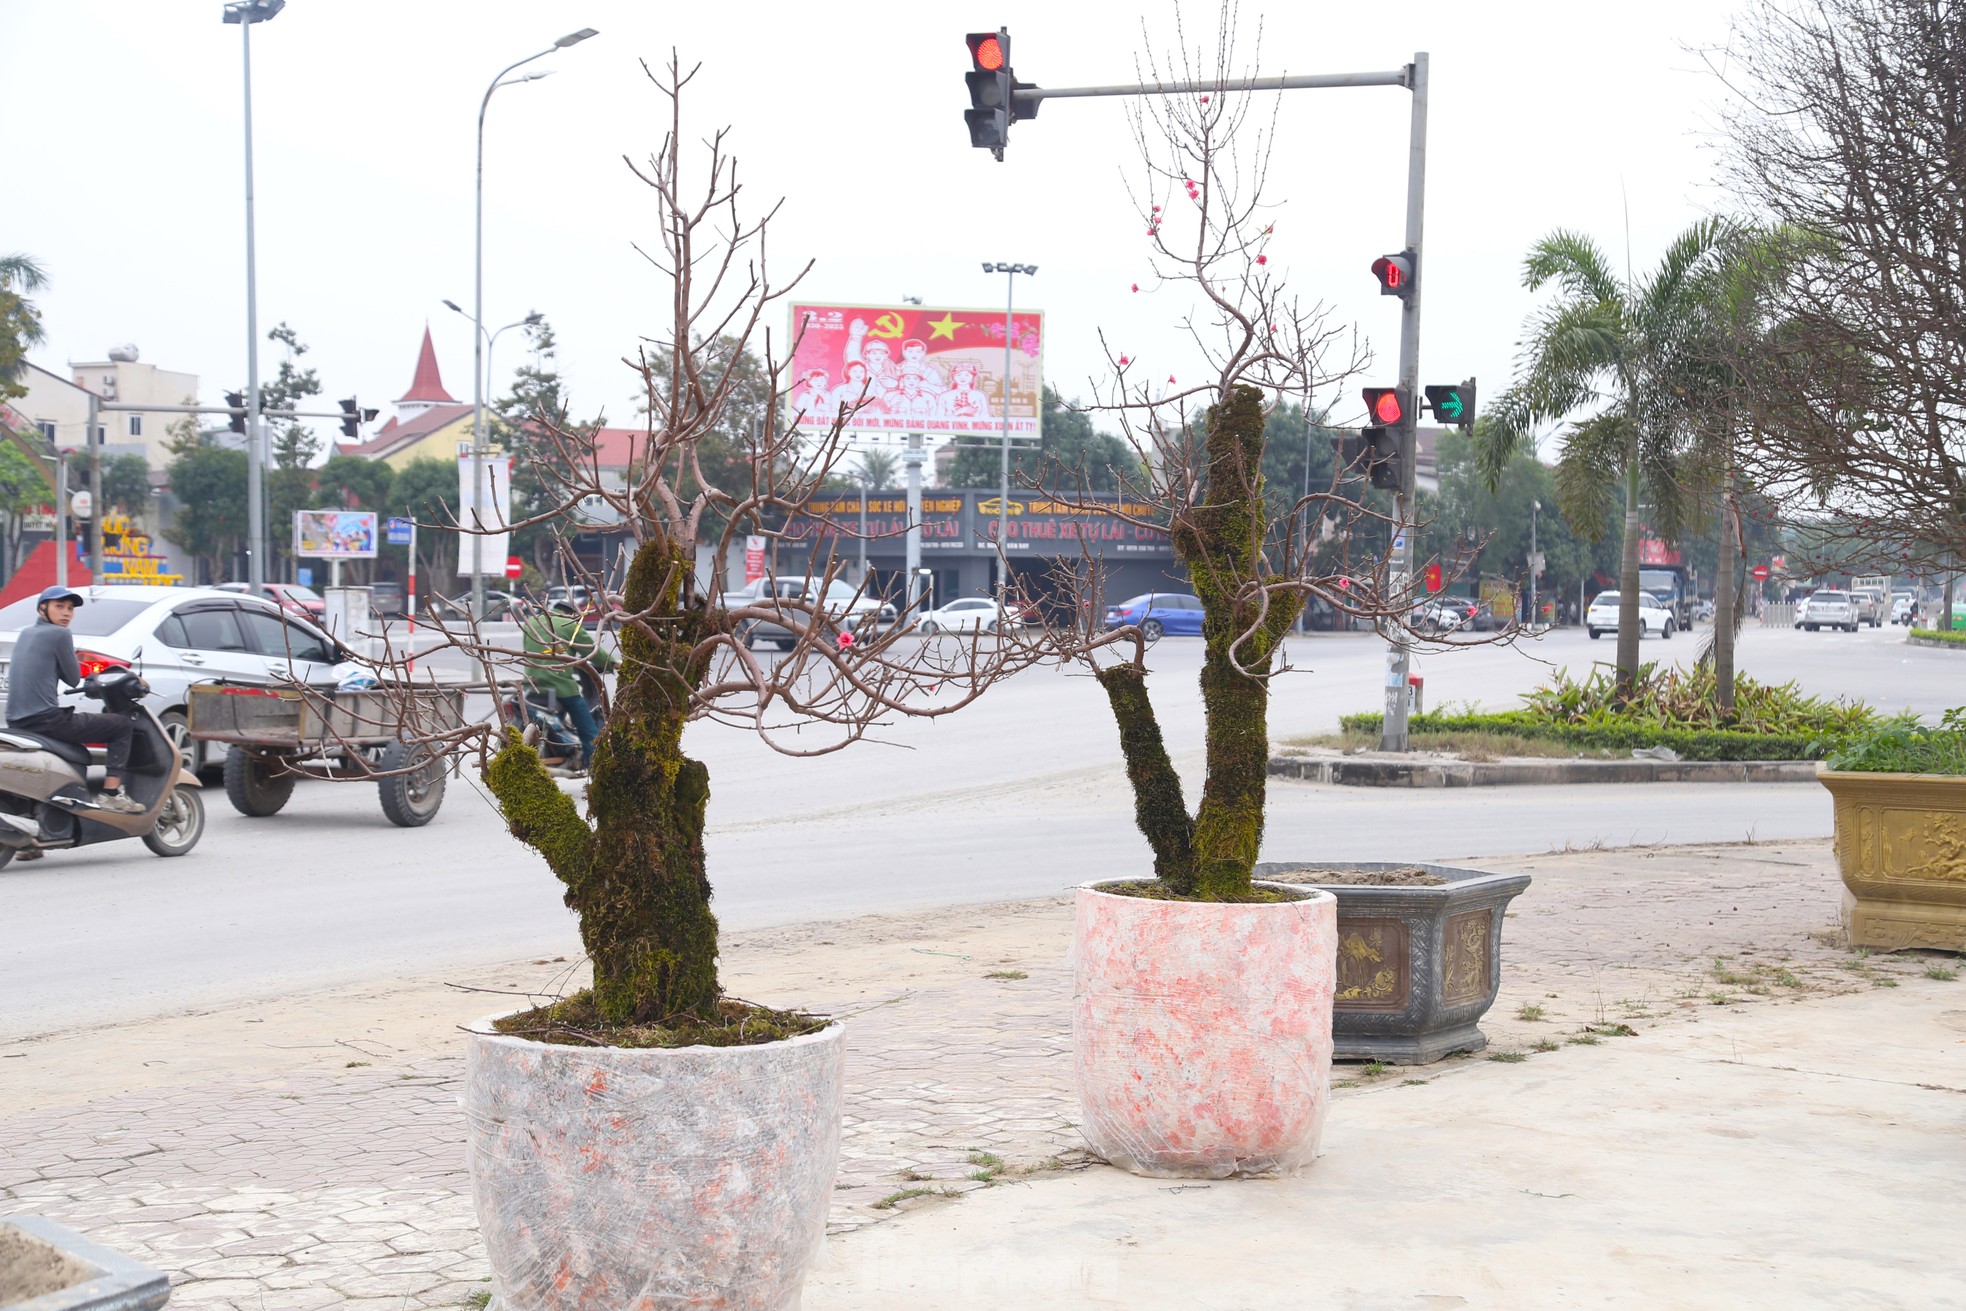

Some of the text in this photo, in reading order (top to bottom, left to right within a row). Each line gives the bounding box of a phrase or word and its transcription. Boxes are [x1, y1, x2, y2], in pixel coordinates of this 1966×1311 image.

[927, 420, 949, 431] QUANG
[995, 420, 1013, 431] XUN
[988, 520, 1018, 538] CO
[1021, 516, 1056, 539] THUÊ
[1102, 518, 1125, 539] LÁI
